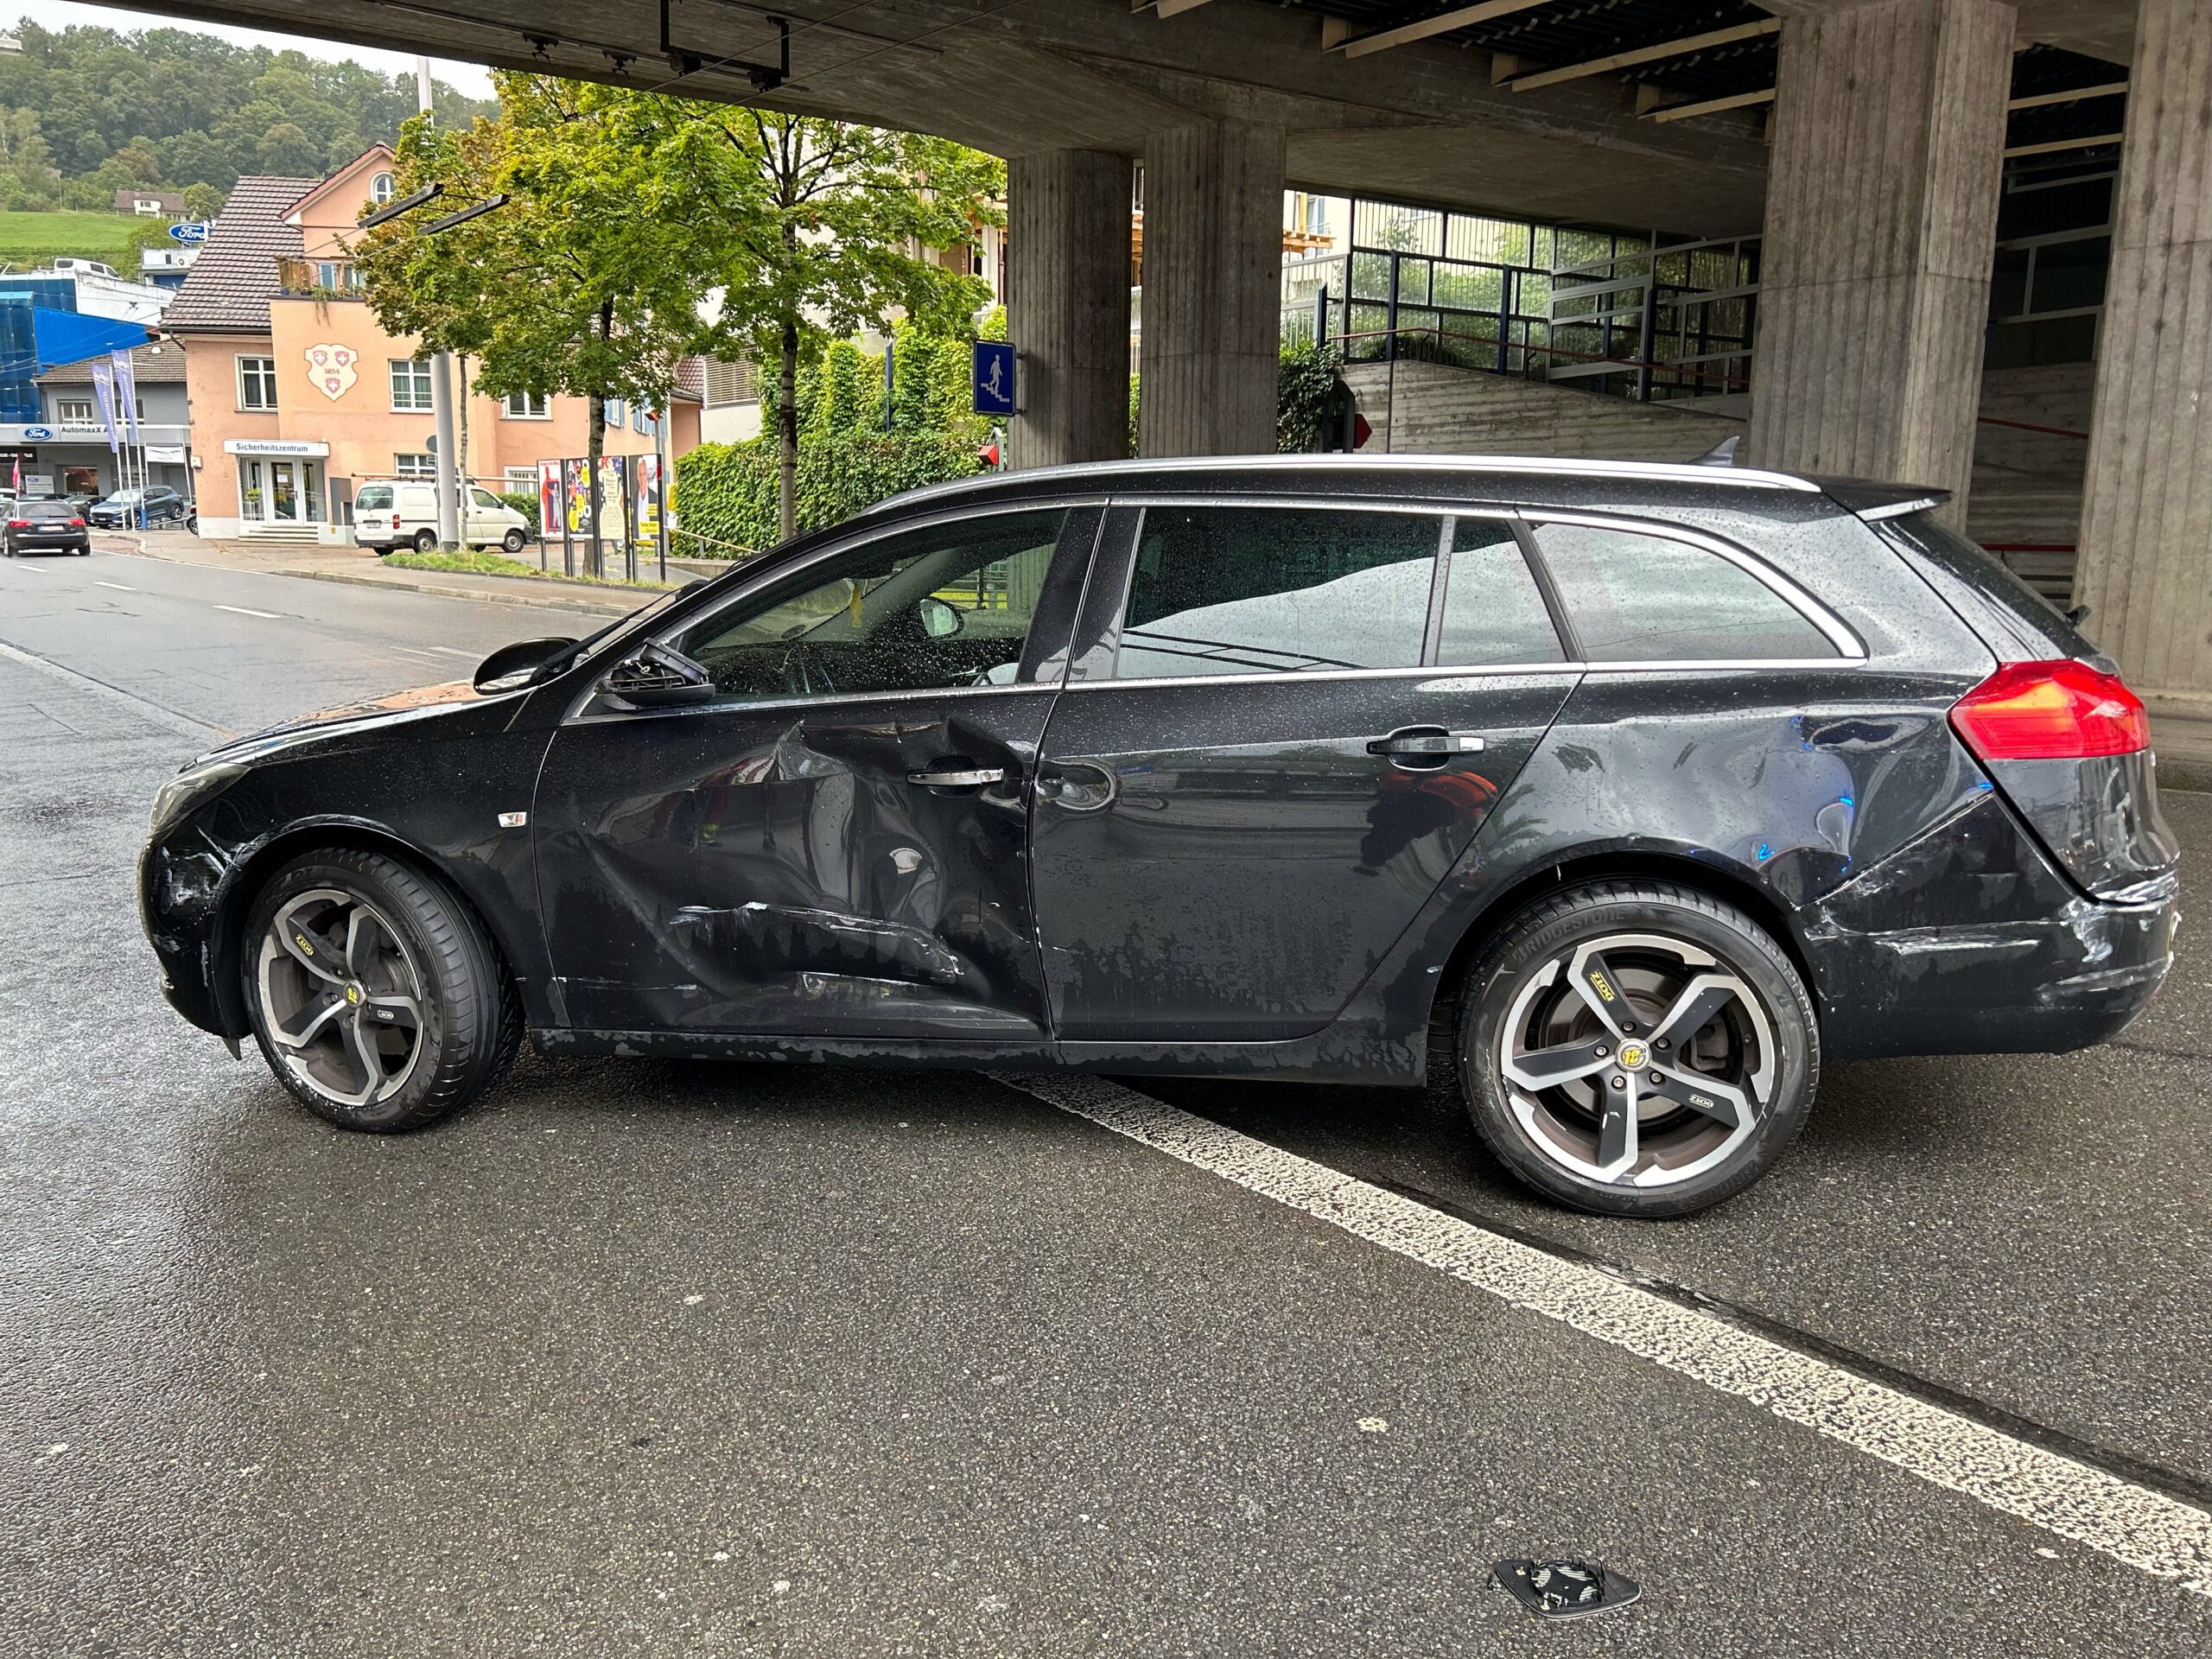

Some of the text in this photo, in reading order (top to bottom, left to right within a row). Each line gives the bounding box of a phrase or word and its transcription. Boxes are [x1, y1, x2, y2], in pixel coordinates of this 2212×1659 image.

[178, 226, 206, 238] Ford
[28, 428, 46, 437] Ford
[236, 442, 308, 452] Sicherheitszentrum
[1513, 907, 1625, 963] BRIDGESTONE
[1590, 970, 1615, 1001] DOTZ
[1688, 1094, 1714, 1108] DOTZ
